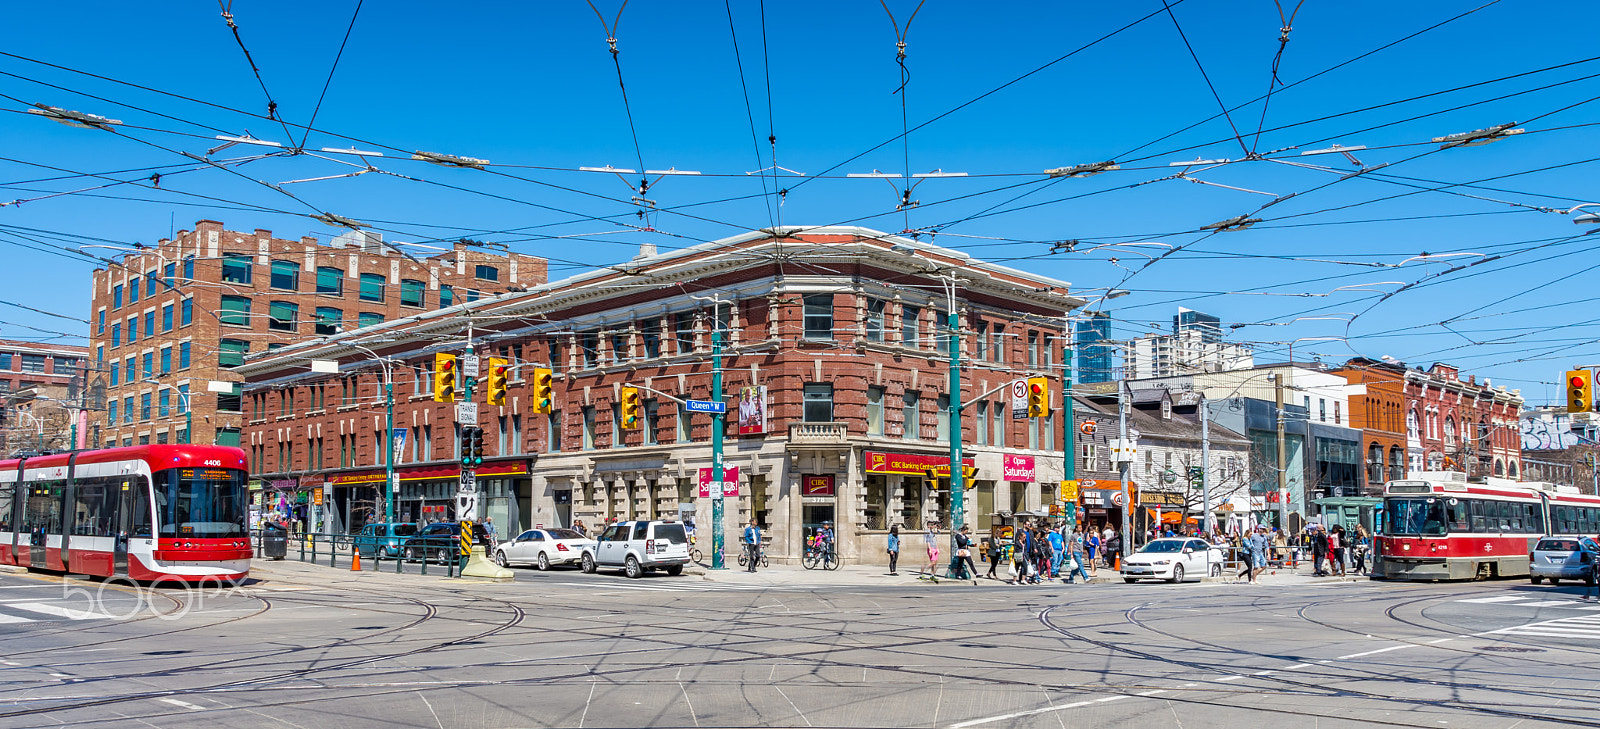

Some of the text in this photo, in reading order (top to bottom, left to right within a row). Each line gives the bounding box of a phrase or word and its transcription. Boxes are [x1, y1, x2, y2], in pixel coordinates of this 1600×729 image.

[460, 404, 476, 413] TRANSIT
[691, 401, 710, 410] Queen
[461, 413, 475, 421] SIGNAL
[873, 455, 885, 463] CIBC
[1013, 457, 1026, 466] Open
[891, 461, 902, 469] CIBC
[902, 462, 919, 471] Banking
[1004, 466, 1035, 479] Saturdays!
[1218, 503, 1235, 511] WIND
